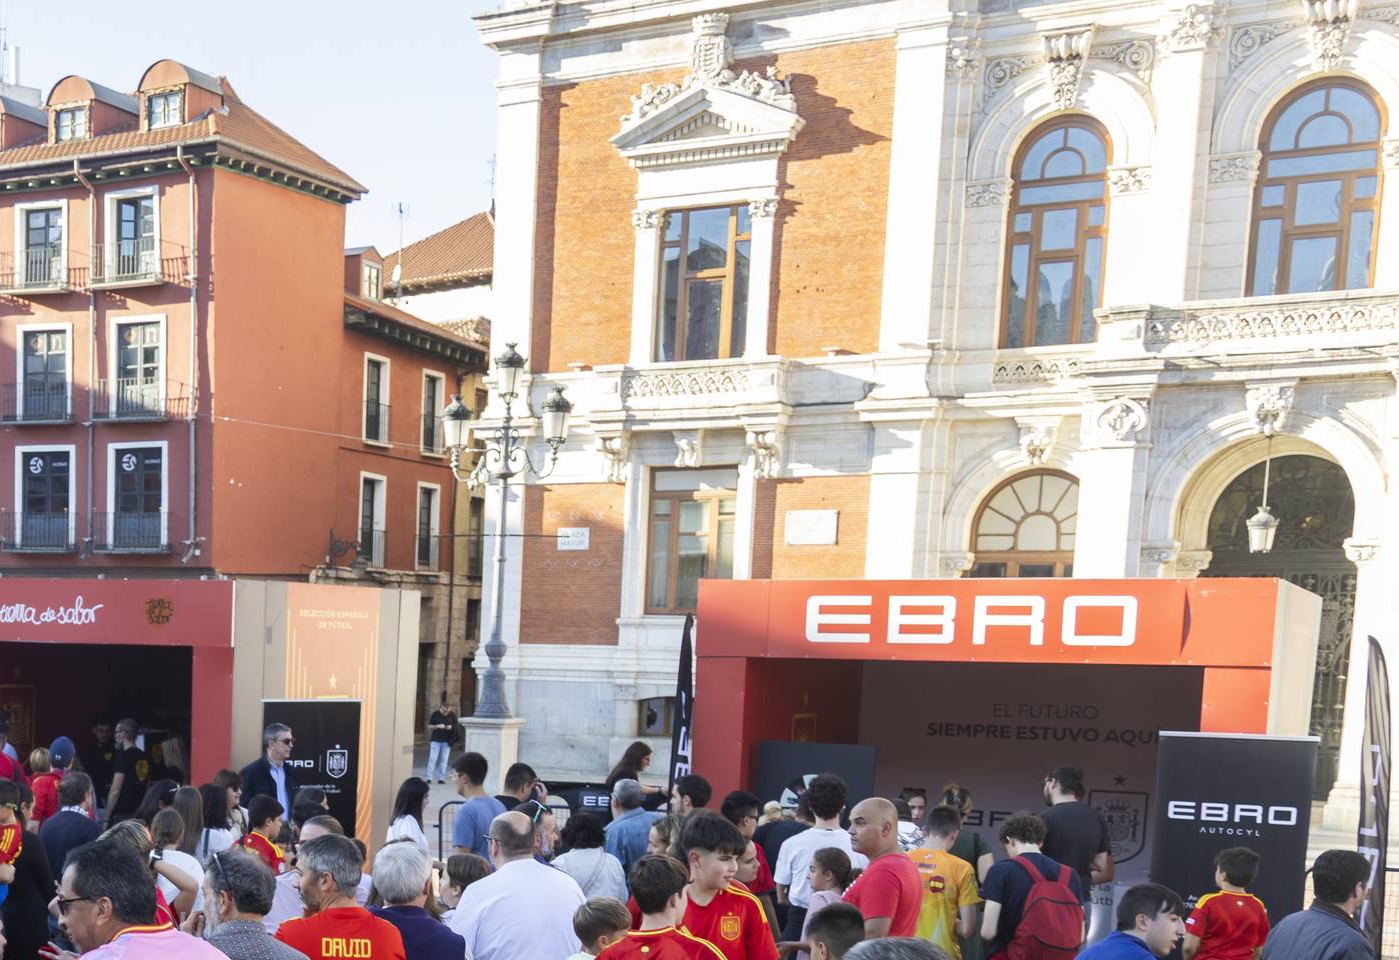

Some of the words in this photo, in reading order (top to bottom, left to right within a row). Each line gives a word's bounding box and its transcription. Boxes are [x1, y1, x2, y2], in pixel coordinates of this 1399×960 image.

[41, 605, 57, 622] de
[57, 596, 105, 625] sabor
[805, 595, 1138, 647] EBRO
[992, 703, 1013, 719] EL
[1018, 704, 1099, 721] FUTURO
[926, 721, 1011, 740] SIEMPRE
[1015, 725, 1099, 743] ESTUVO
[1167, 800, 1298, 826] EBRO
[1199, 826, 1261, 837] AUTOCYL
